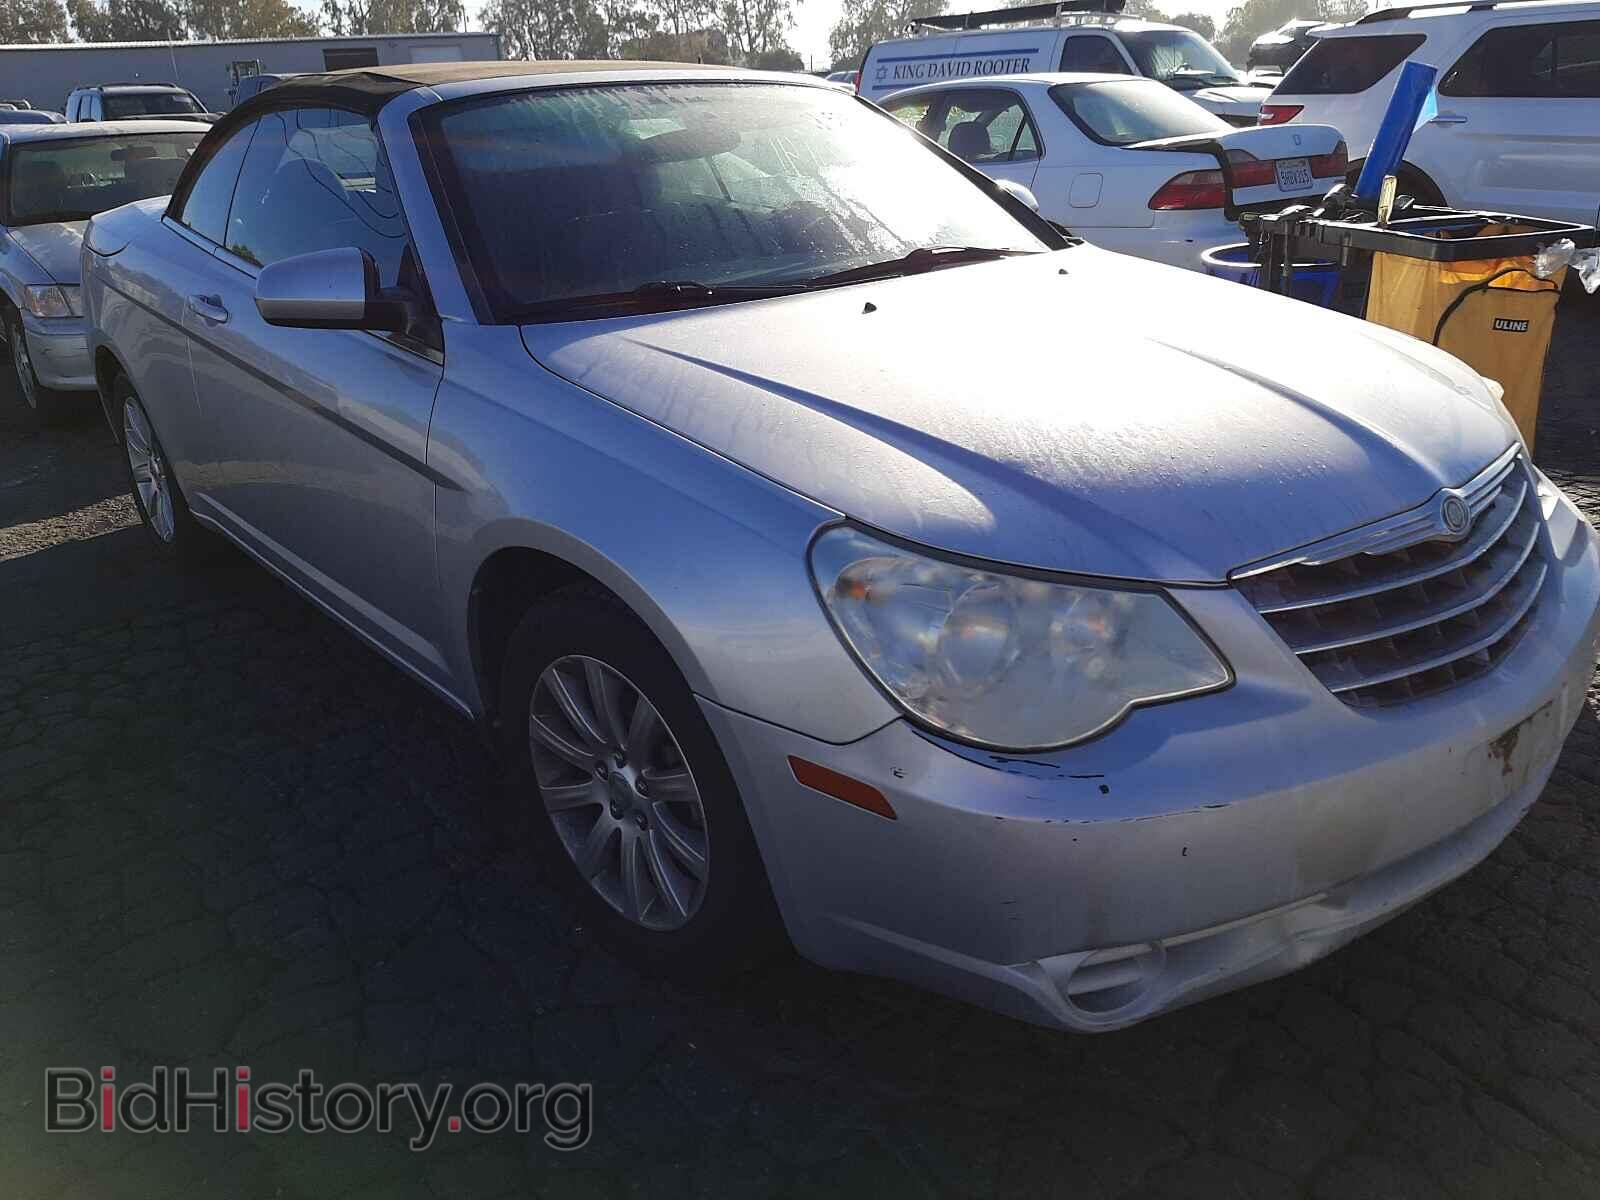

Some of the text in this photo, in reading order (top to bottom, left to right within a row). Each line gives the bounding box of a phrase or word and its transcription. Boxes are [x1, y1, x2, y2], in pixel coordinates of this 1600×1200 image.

[893, 57, 1031, 80] KING DAVID ROOTER
[1495, 319, 1528, 331] ULINE
